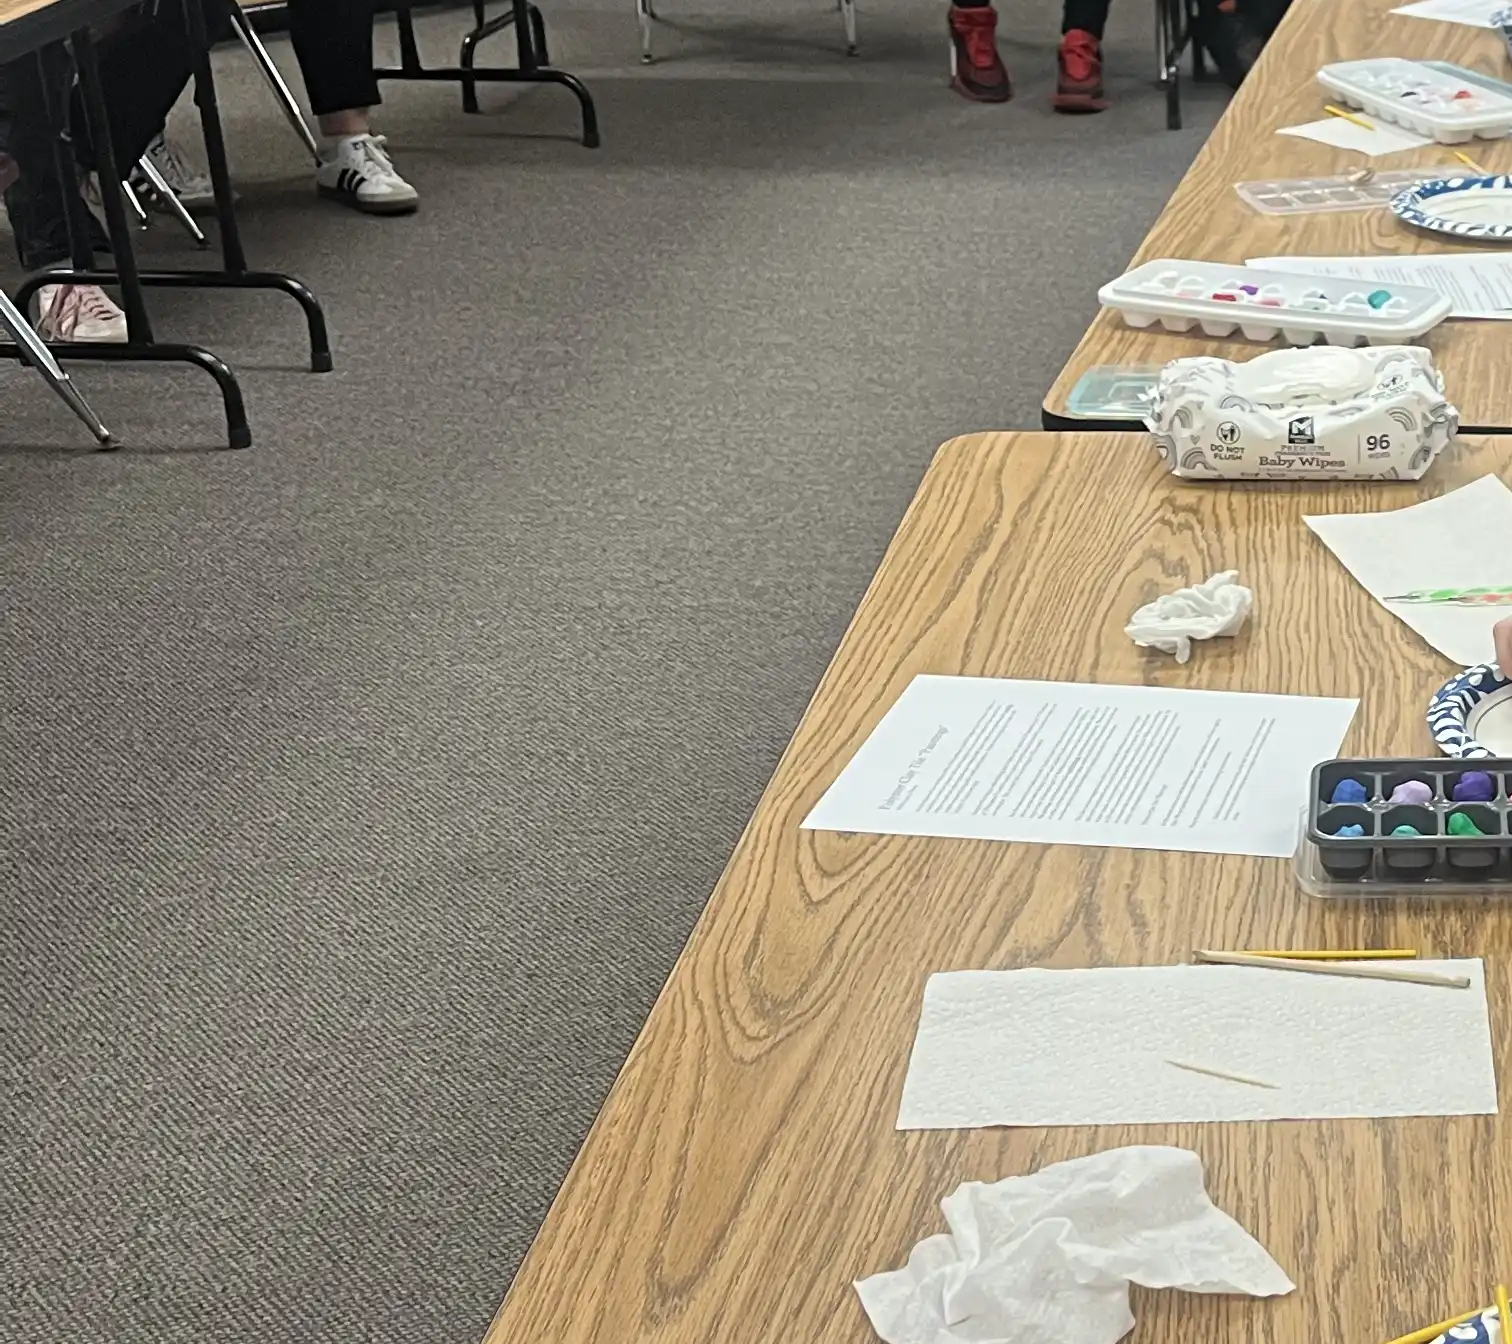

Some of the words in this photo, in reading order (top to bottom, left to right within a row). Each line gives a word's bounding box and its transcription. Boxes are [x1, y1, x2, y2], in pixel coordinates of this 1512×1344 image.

[1366, 433, 1391, 451] 96
[1210, 443, 1224, 452] DO
[1226, 445, 1245, 454] NOT
[1213, 452, 1243, 461] FLUSH
[1258, 455, 1296, 469] Baby
[1297, 456, 1346, 469] Wipes
